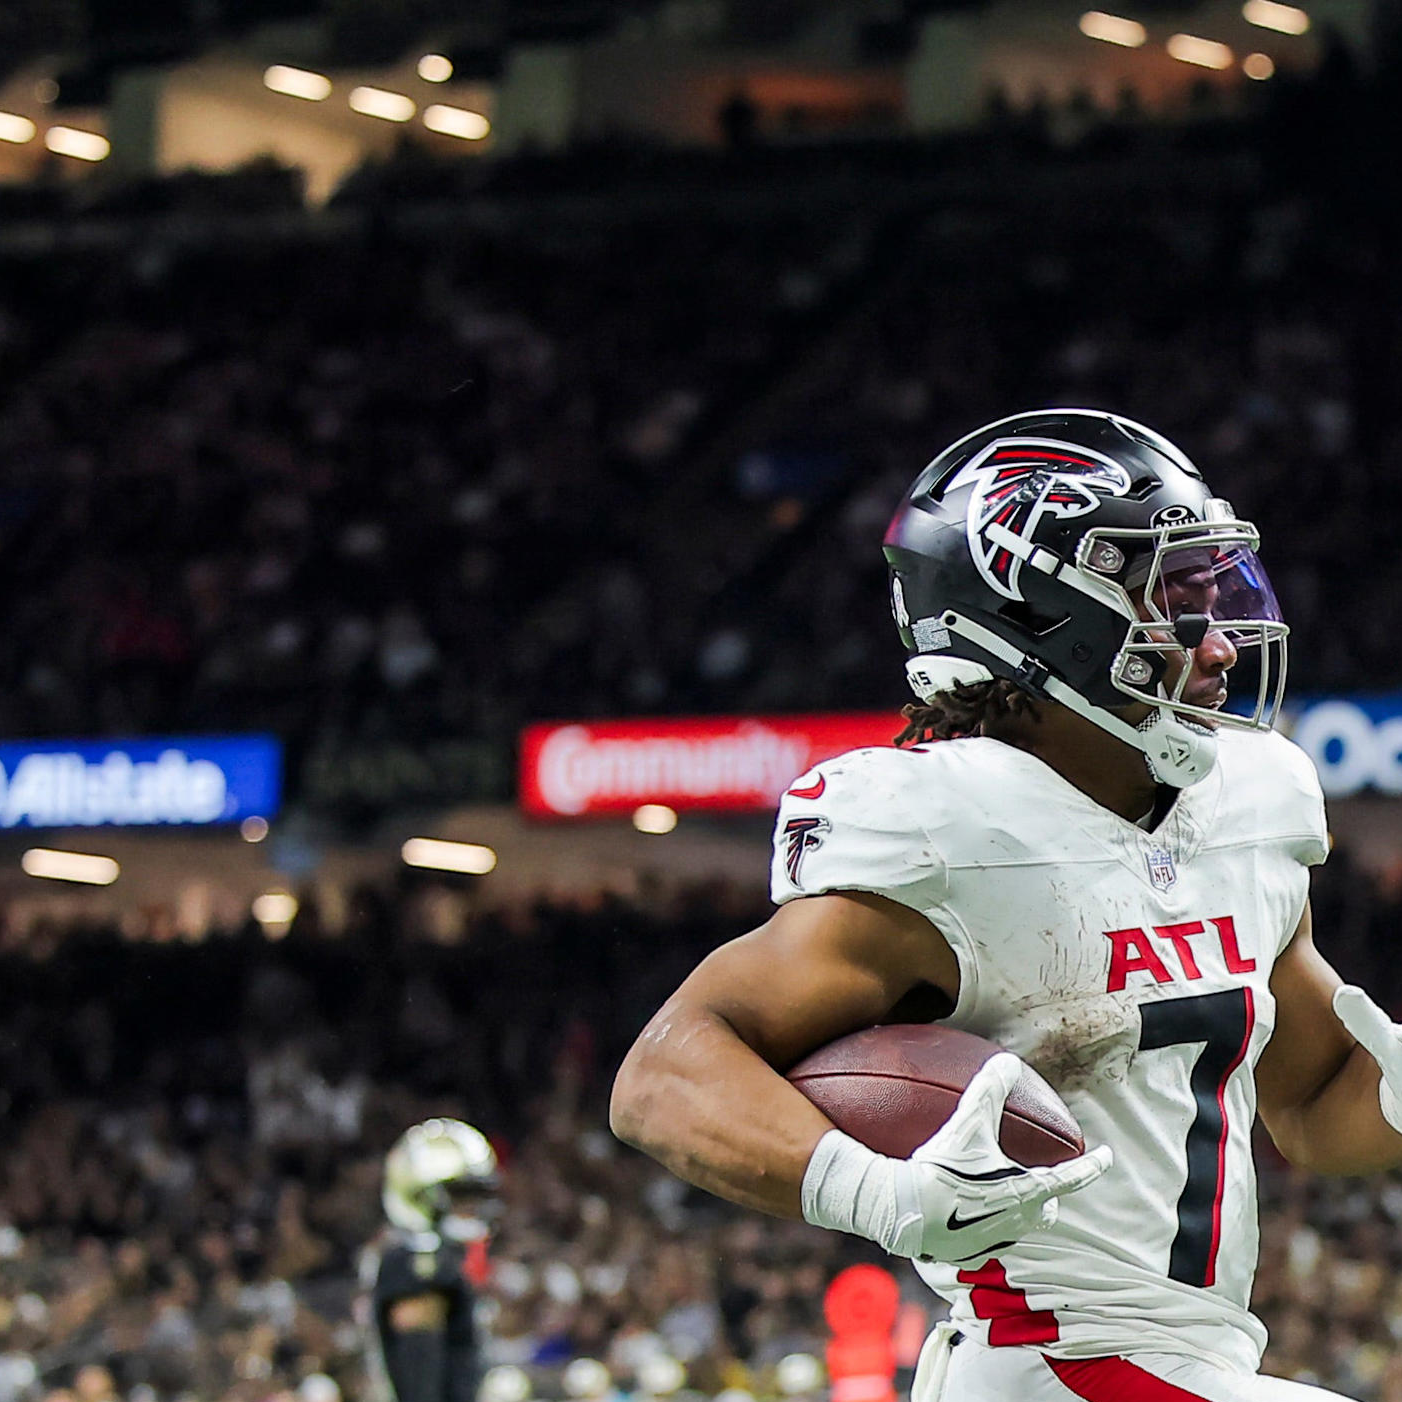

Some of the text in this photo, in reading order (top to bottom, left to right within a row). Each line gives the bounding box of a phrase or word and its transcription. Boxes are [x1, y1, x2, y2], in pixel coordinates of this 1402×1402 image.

[0, 749, 227, 828] Allstate
[538, 720, 811, 816] Community
[1152, 866, 1174, 884] NFL
[1102, 915, 1256, 993] ATL
[1138, 986, 1255, 1288] 7
